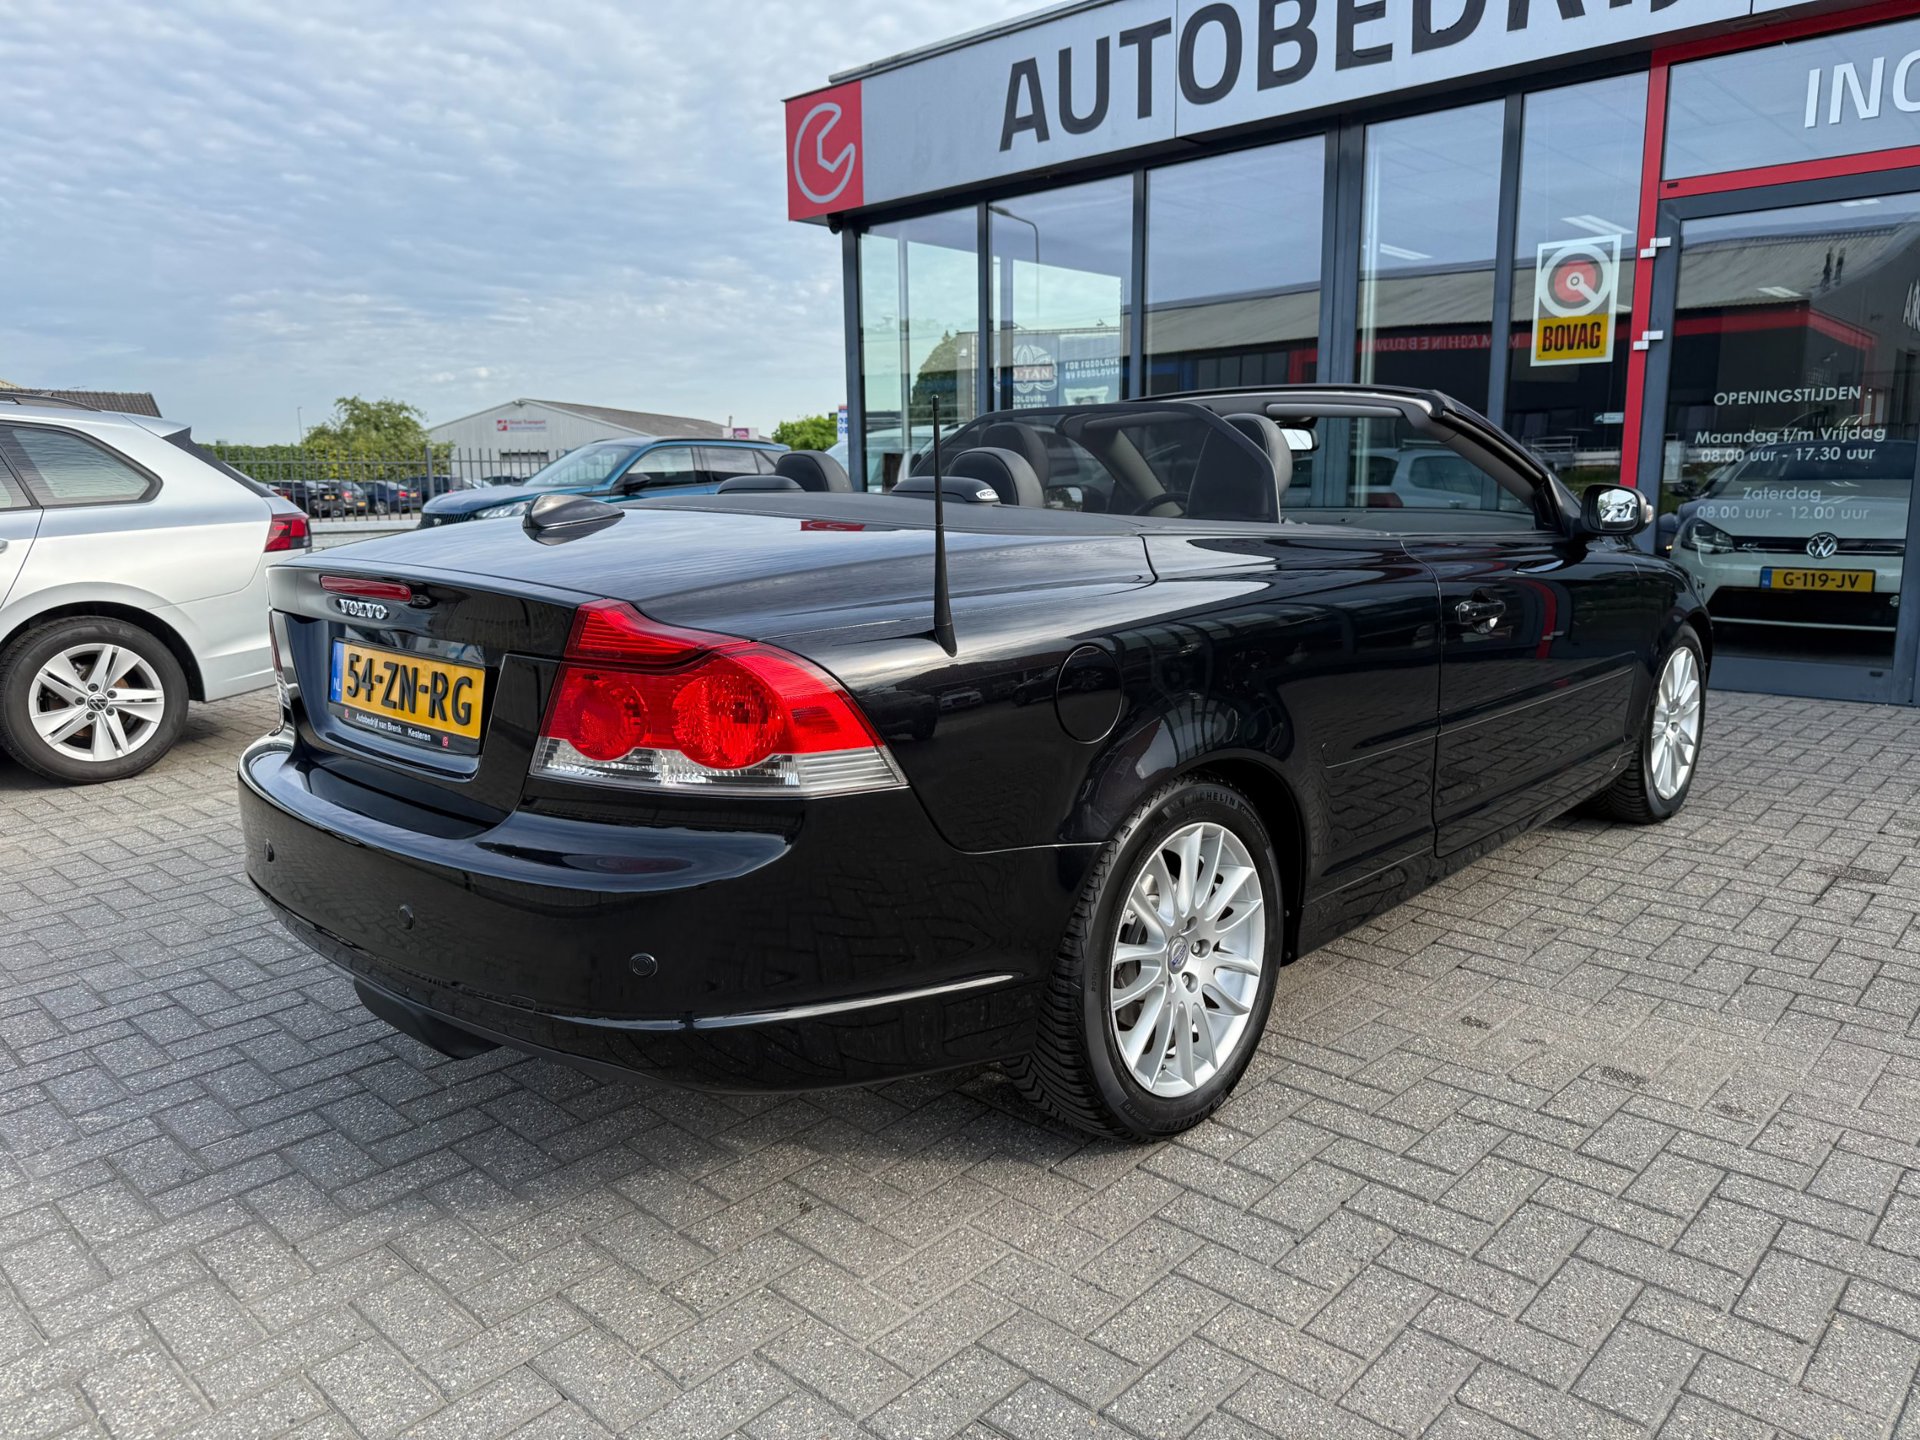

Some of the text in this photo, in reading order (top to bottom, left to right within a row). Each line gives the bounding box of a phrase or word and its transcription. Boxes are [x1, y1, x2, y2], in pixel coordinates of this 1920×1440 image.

[999, 0, 1680, 152] AUTOBE
[1542, 321, 1602, 352] BOVAG
[1713, 385, 1862, 406] OPENINGSTIJDEN
[1694, 426, 1887, 446] Maandag t/m Vrijdag
[1700, 449, 1745, 463] 08.00
[1750, 451, 1777, 462] uur
[1795, 446, 1841, 461] 17.30
[1846, 448, 1876, 460] uur
[1743, 487, 1822, 503] Zaterdag
[1696, 505, 1740, 519] 08.00
[1745, 507, 1772, 519] uur
[1791, 506, 1836, 520] 12.00
[1841, 507, 1870, 520] uur
[1783, 571, 1860, 589] G-119-JV
[338, 598, 388, 620] VOLVO
[333, 653, 473, 726] NL 54-ZN-RG
[407, 727, 431, 741] Kesteren
